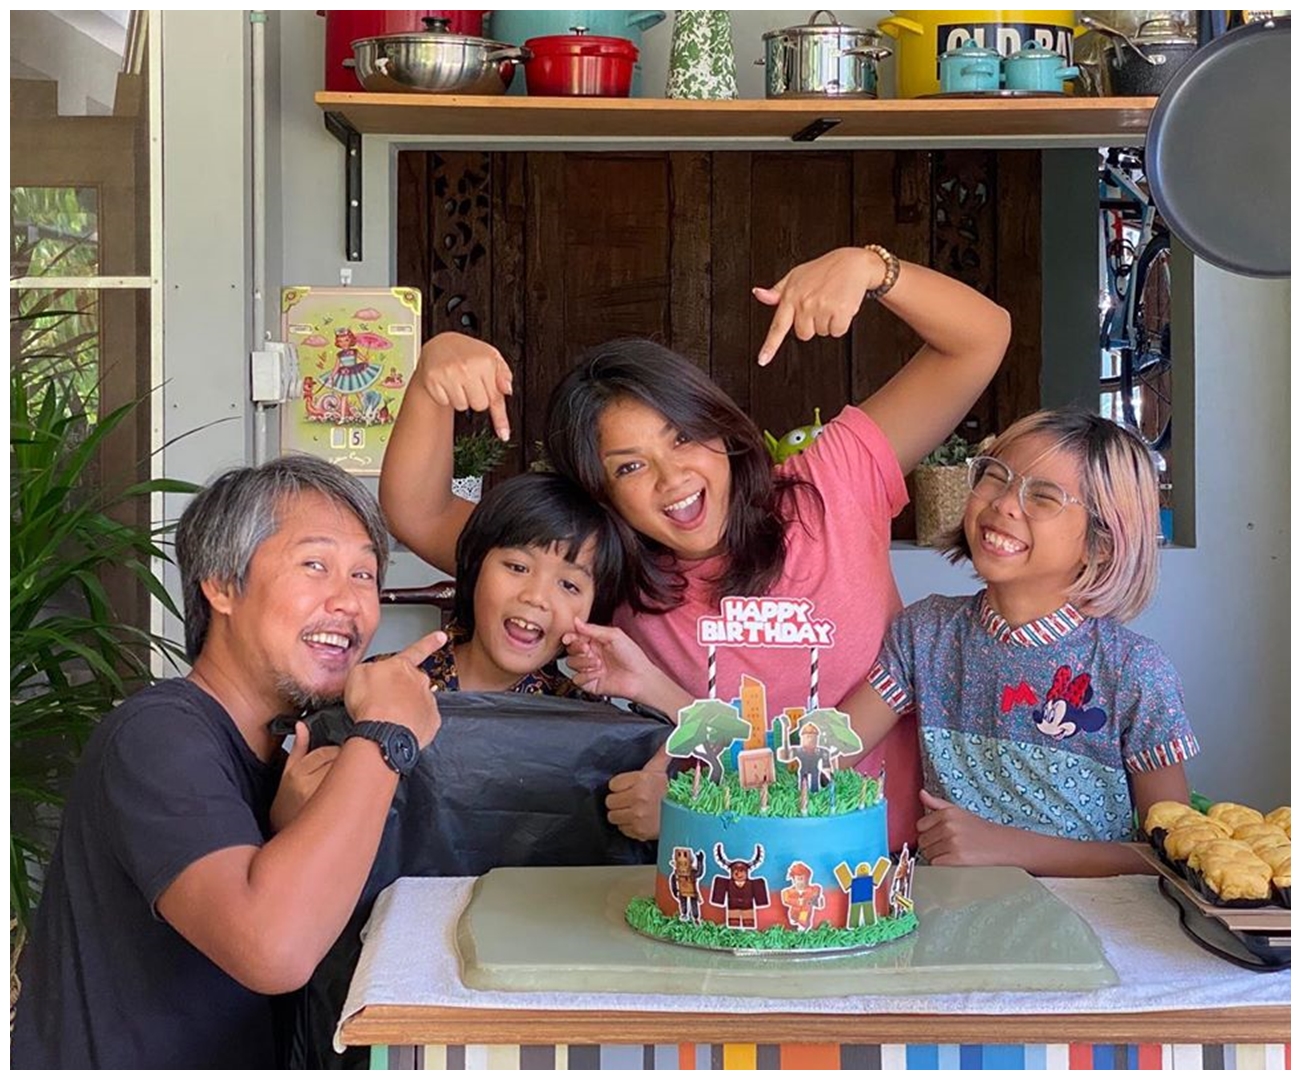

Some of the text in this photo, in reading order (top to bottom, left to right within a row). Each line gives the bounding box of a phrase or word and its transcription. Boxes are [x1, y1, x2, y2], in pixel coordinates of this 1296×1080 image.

[353, 431, 360, 445] 5
[725, 600, 809, 623] HAPPY
[701, 620, 831, 643] BIRTHDAY
